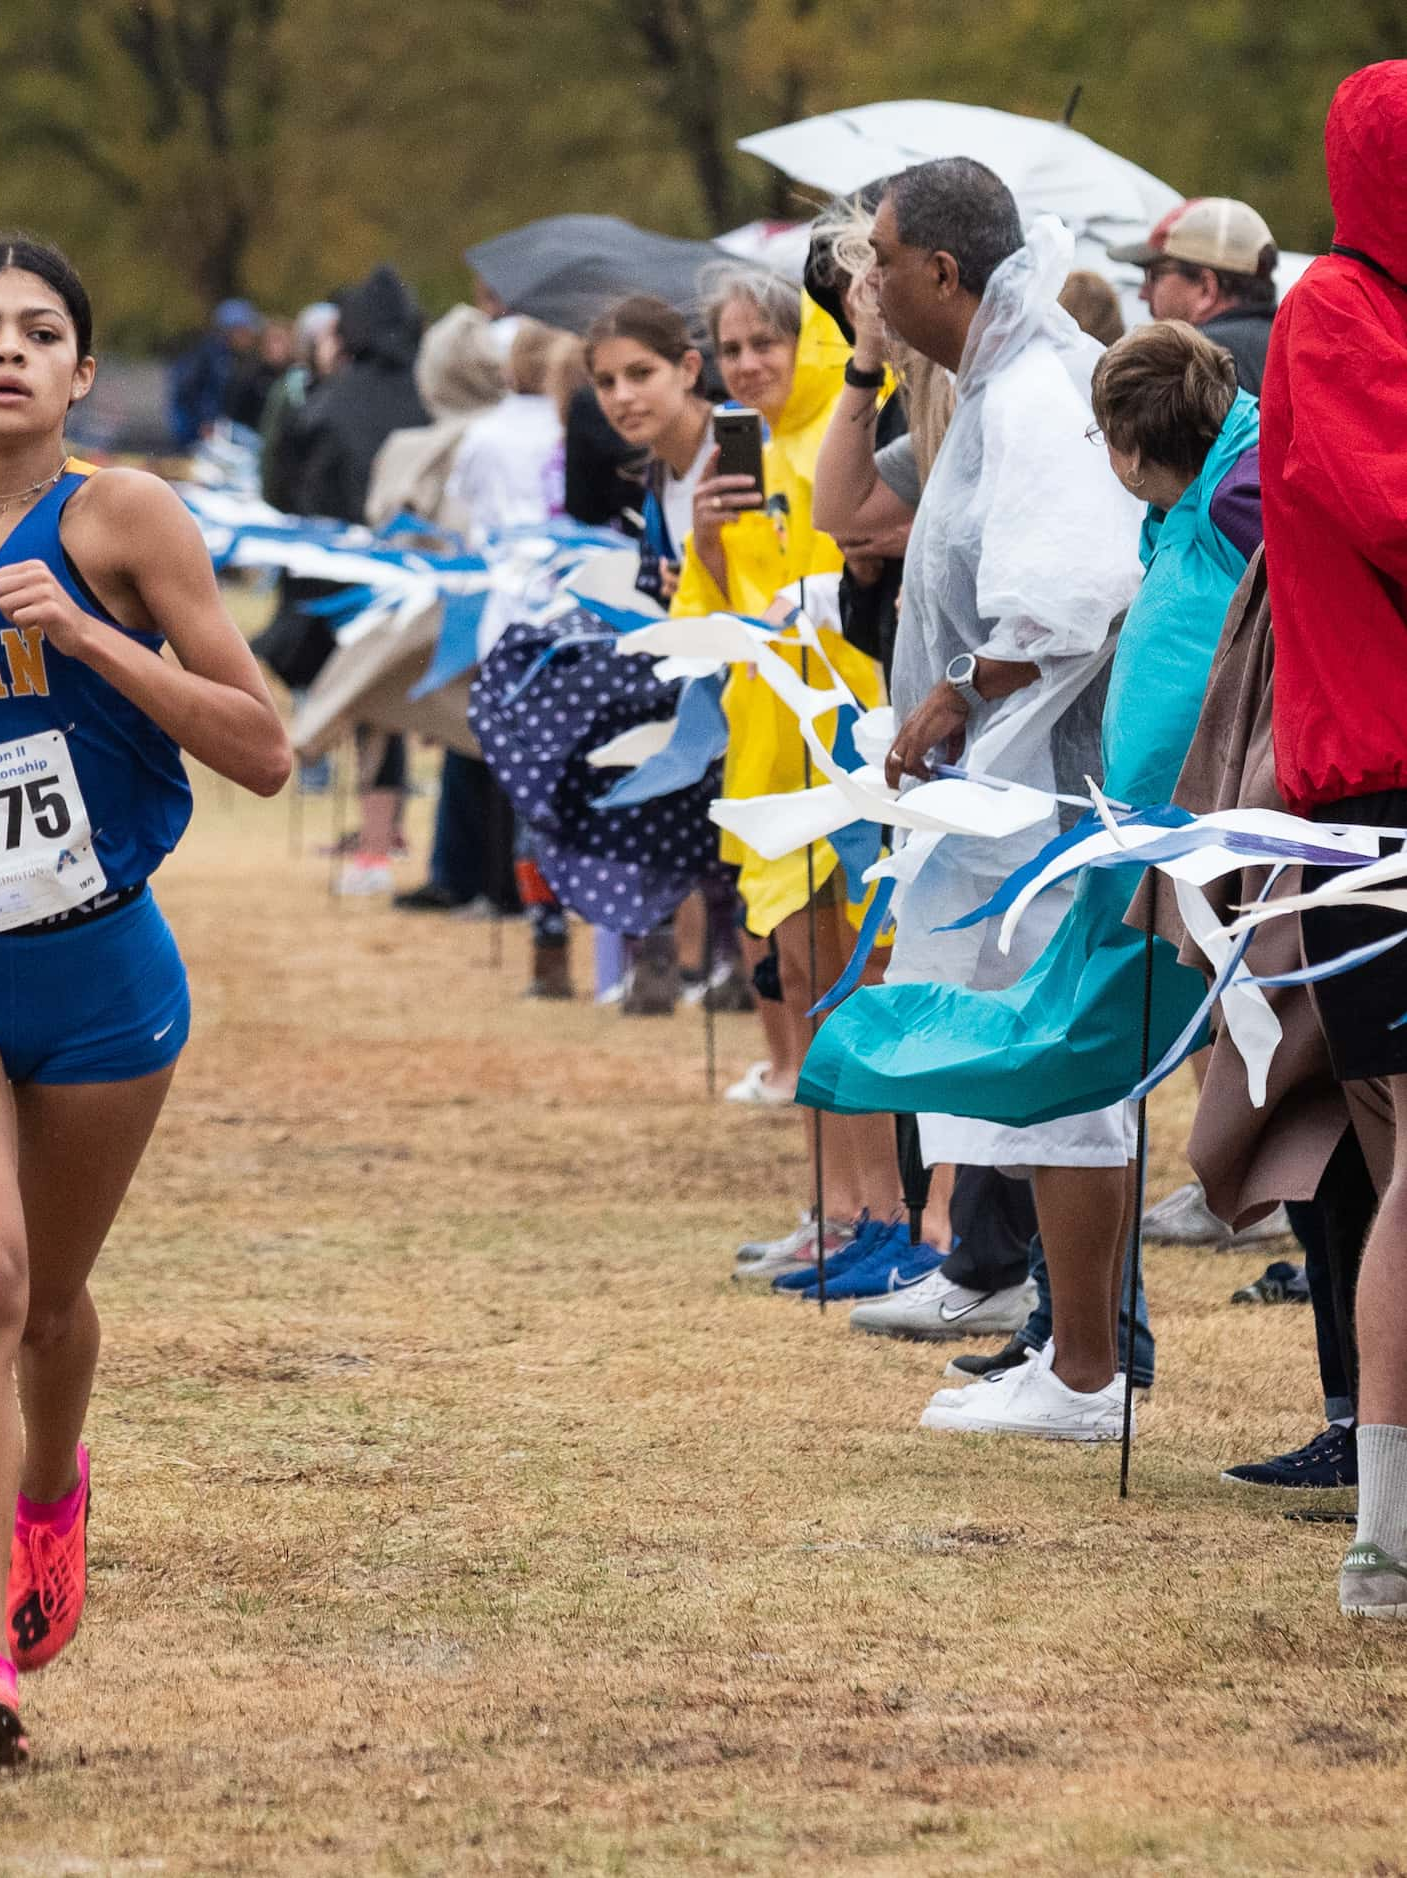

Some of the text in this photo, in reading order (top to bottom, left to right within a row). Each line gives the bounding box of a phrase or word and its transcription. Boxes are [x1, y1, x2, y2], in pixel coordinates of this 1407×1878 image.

[16, 745, 26, 757] II
[79, 877, 96, 890] 1975
[1345, 1552, 1377, 1566] NIKE
